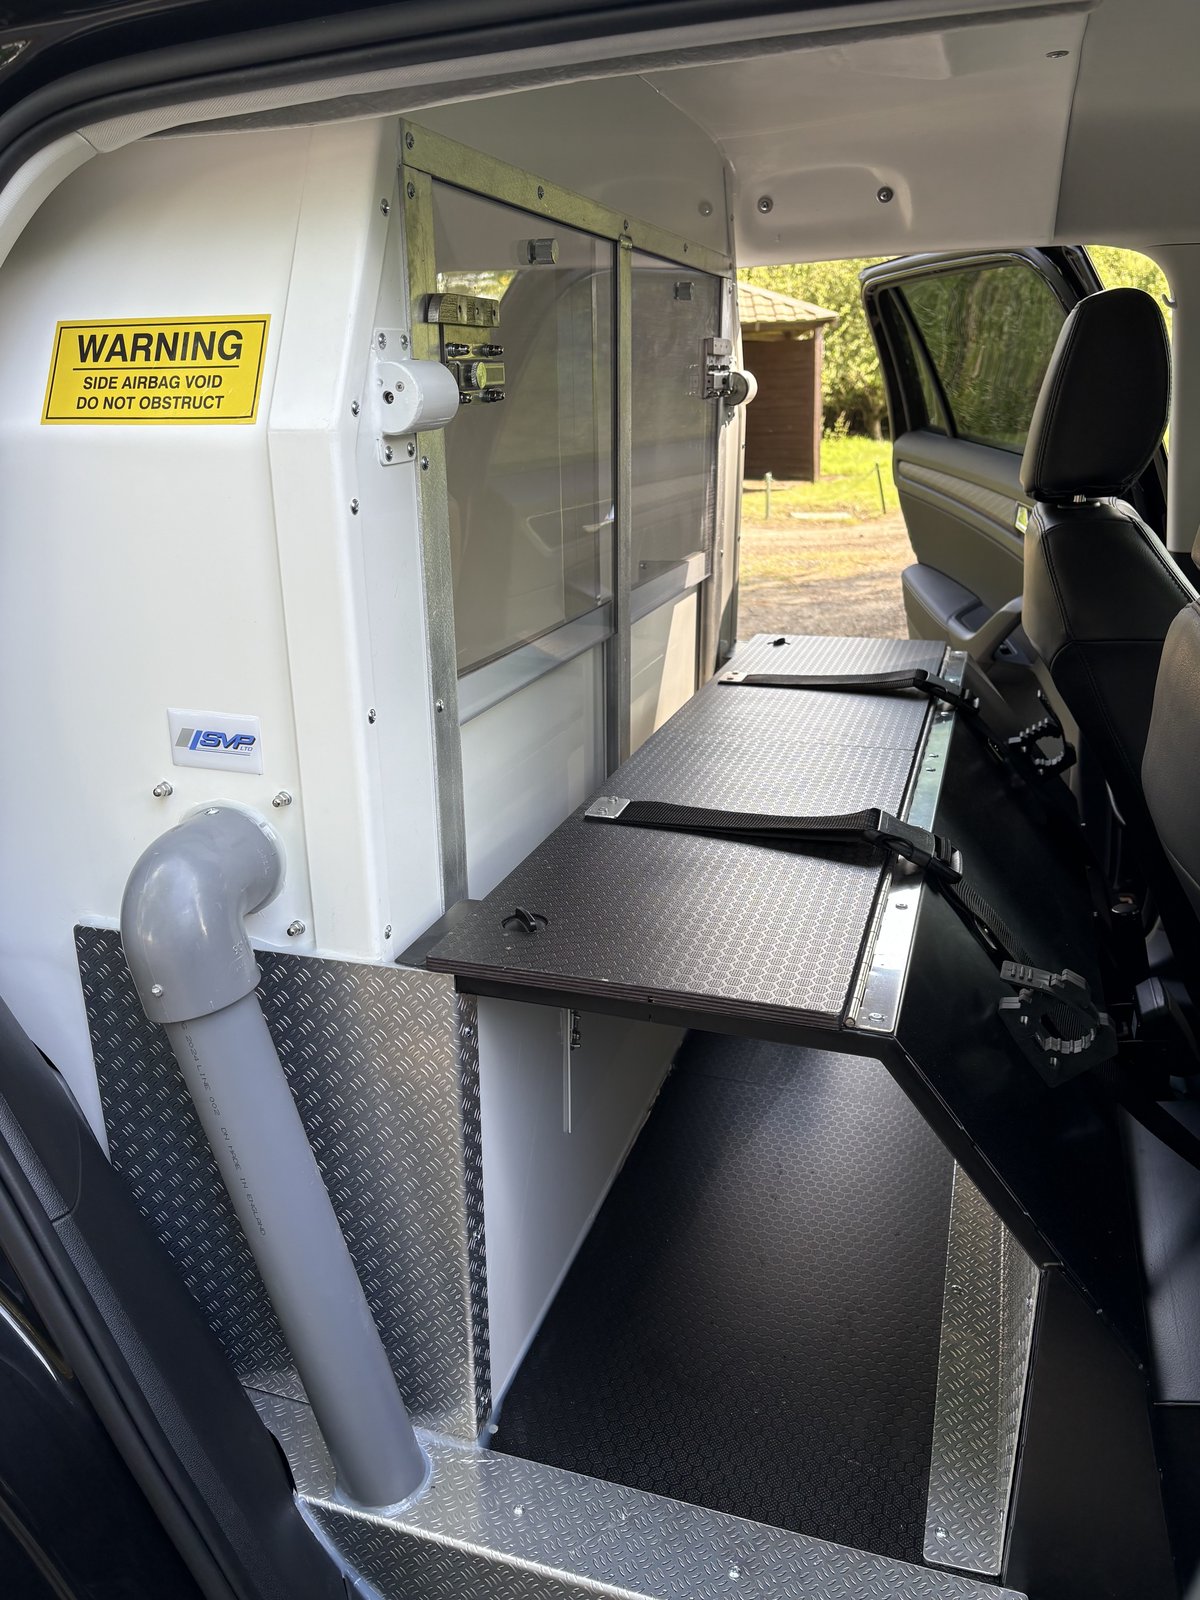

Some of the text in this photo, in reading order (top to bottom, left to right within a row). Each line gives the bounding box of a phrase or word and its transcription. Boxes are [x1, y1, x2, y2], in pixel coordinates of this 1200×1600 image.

[77, 329, 243, 363] WARNING
[83, 374, 223, 390] SIDE AIRBAG VOID
[76, 395, 225, 410] DO NOT OBSTRUCT
[199, 730, 256, 750] SVP
[185, 1035, 199, 1063] 2024
[196, 1064, 211, 1091] LINE
[209, 1096, 221, 1116] 002
[228, 1145, 242, 1171] MADE
[239, 1177, 249, 1189] IN
[246, 1193, 267, 1236] ENGLAND
